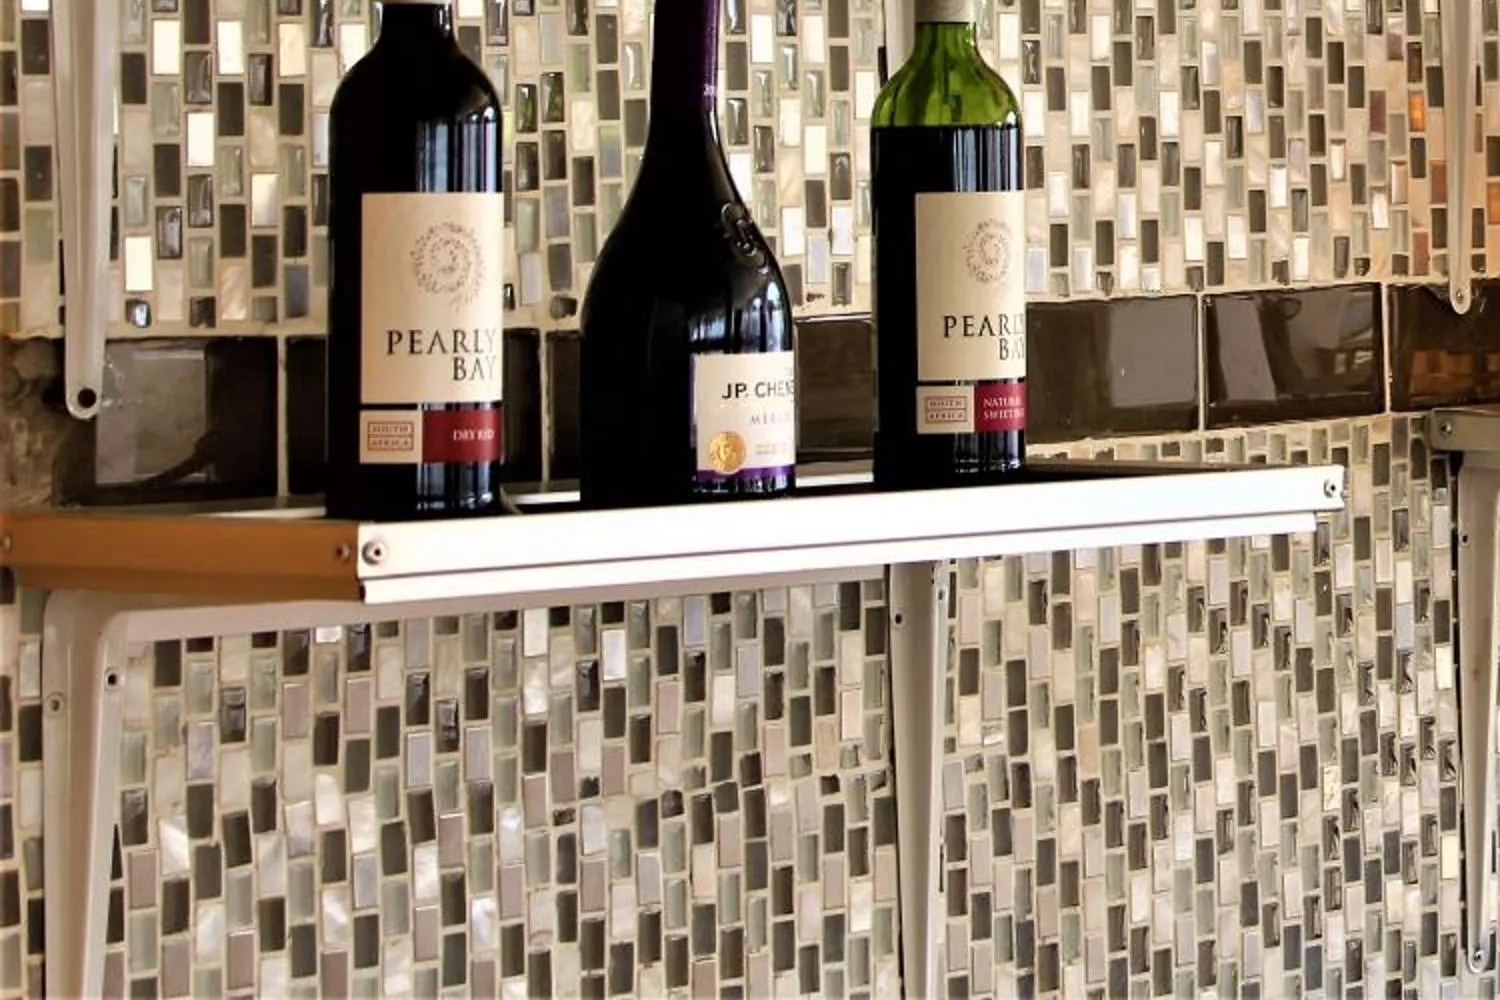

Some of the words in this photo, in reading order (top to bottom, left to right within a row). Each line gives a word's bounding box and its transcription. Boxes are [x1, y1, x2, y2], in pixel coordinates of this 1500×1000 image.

[386, 328, 498, 355] PEARLY
[452, 355, 498, 381] BAY
[721, 382, 749, 400] JP.
[453, 428, 476, 442] DRY
[475, 428, 496, 442] RED
